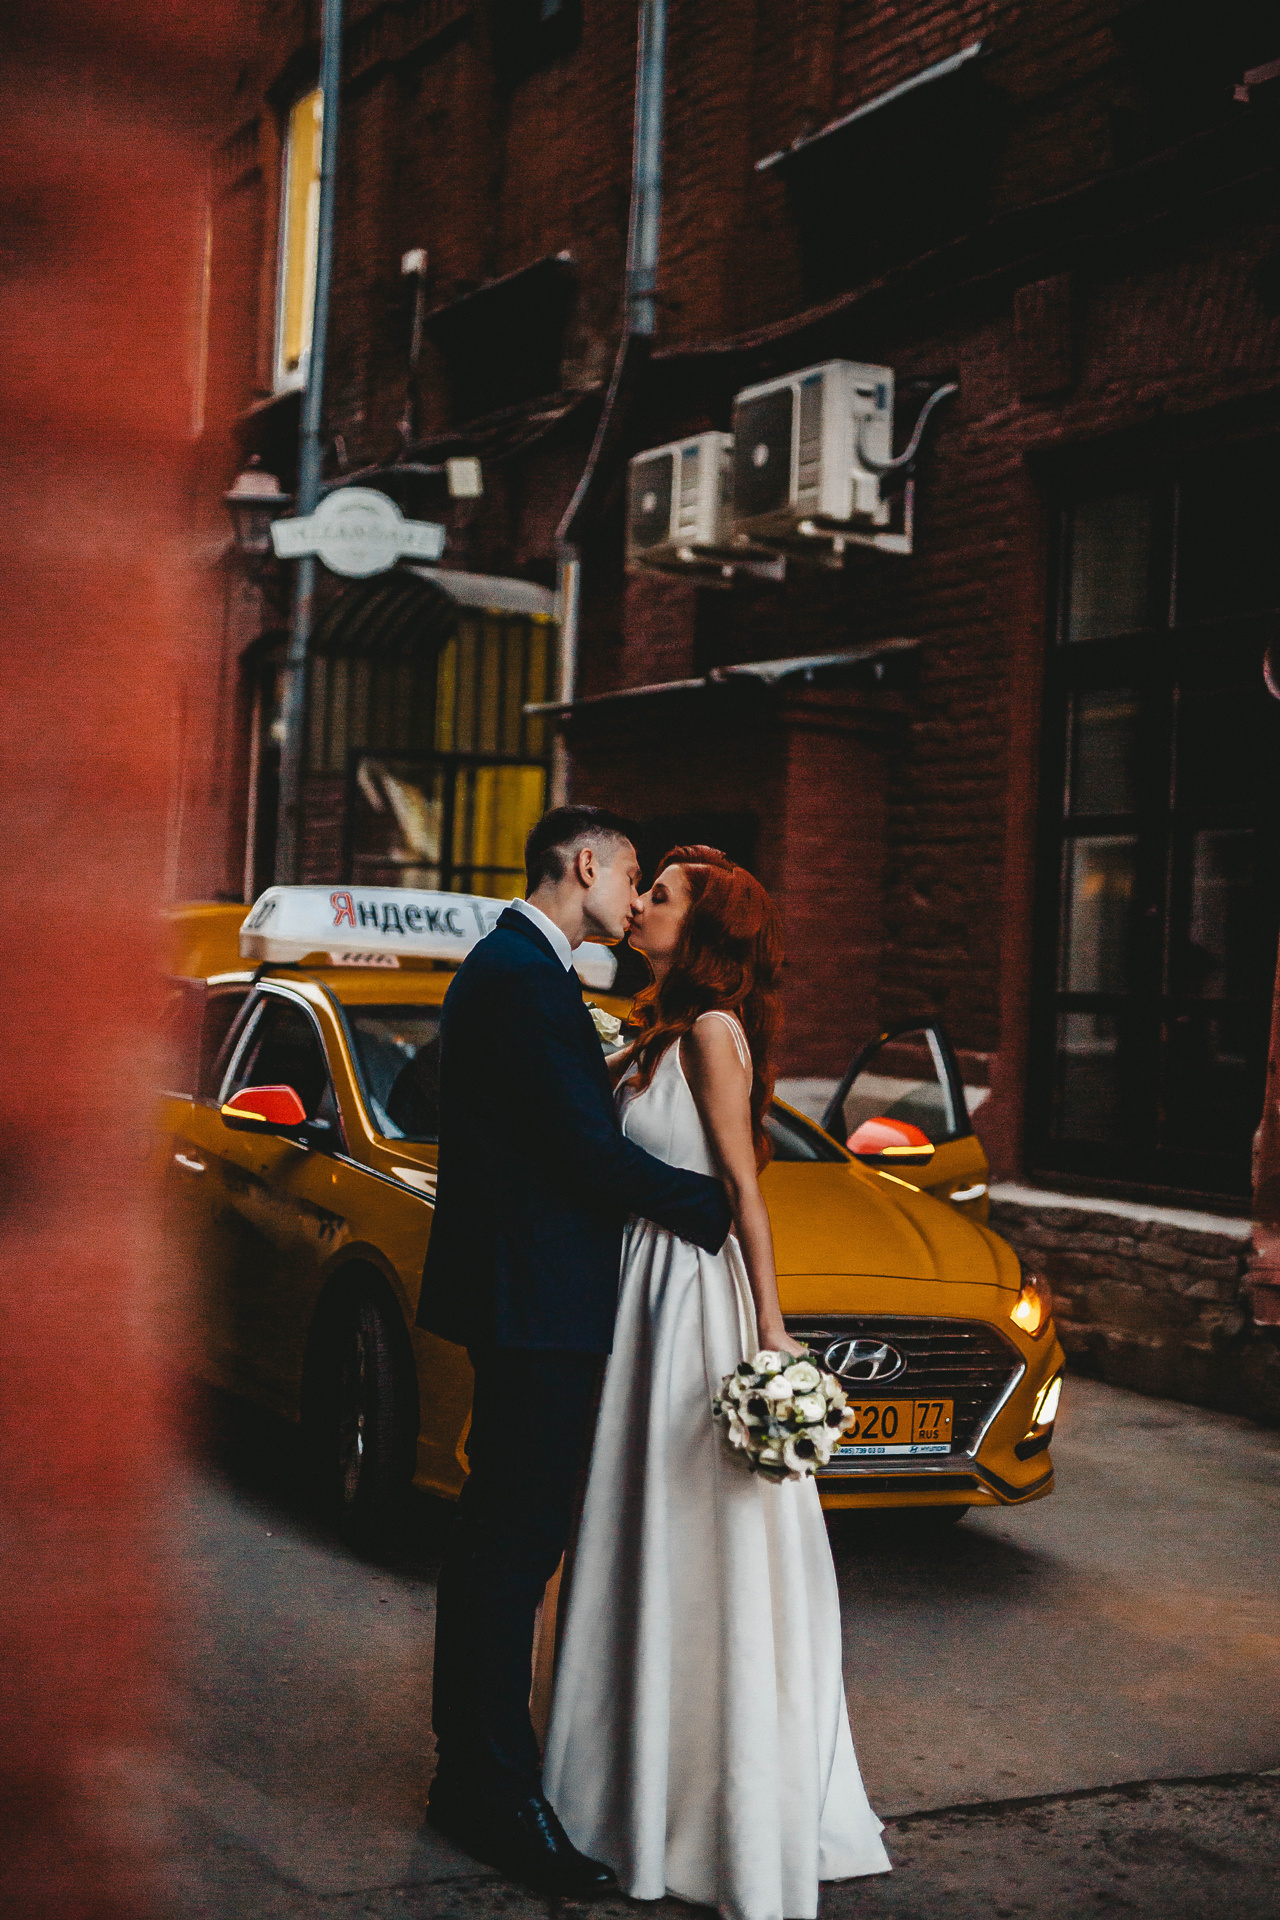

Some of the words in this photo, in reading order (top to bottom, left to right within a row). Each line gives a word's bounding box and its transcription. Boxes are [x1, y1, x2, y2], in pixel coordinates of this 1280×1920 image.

[330, 891, 465, 938] Яндекс
[917, 1402, 944, 1429] 77
[918, 1429, 939, 1439] RUS
